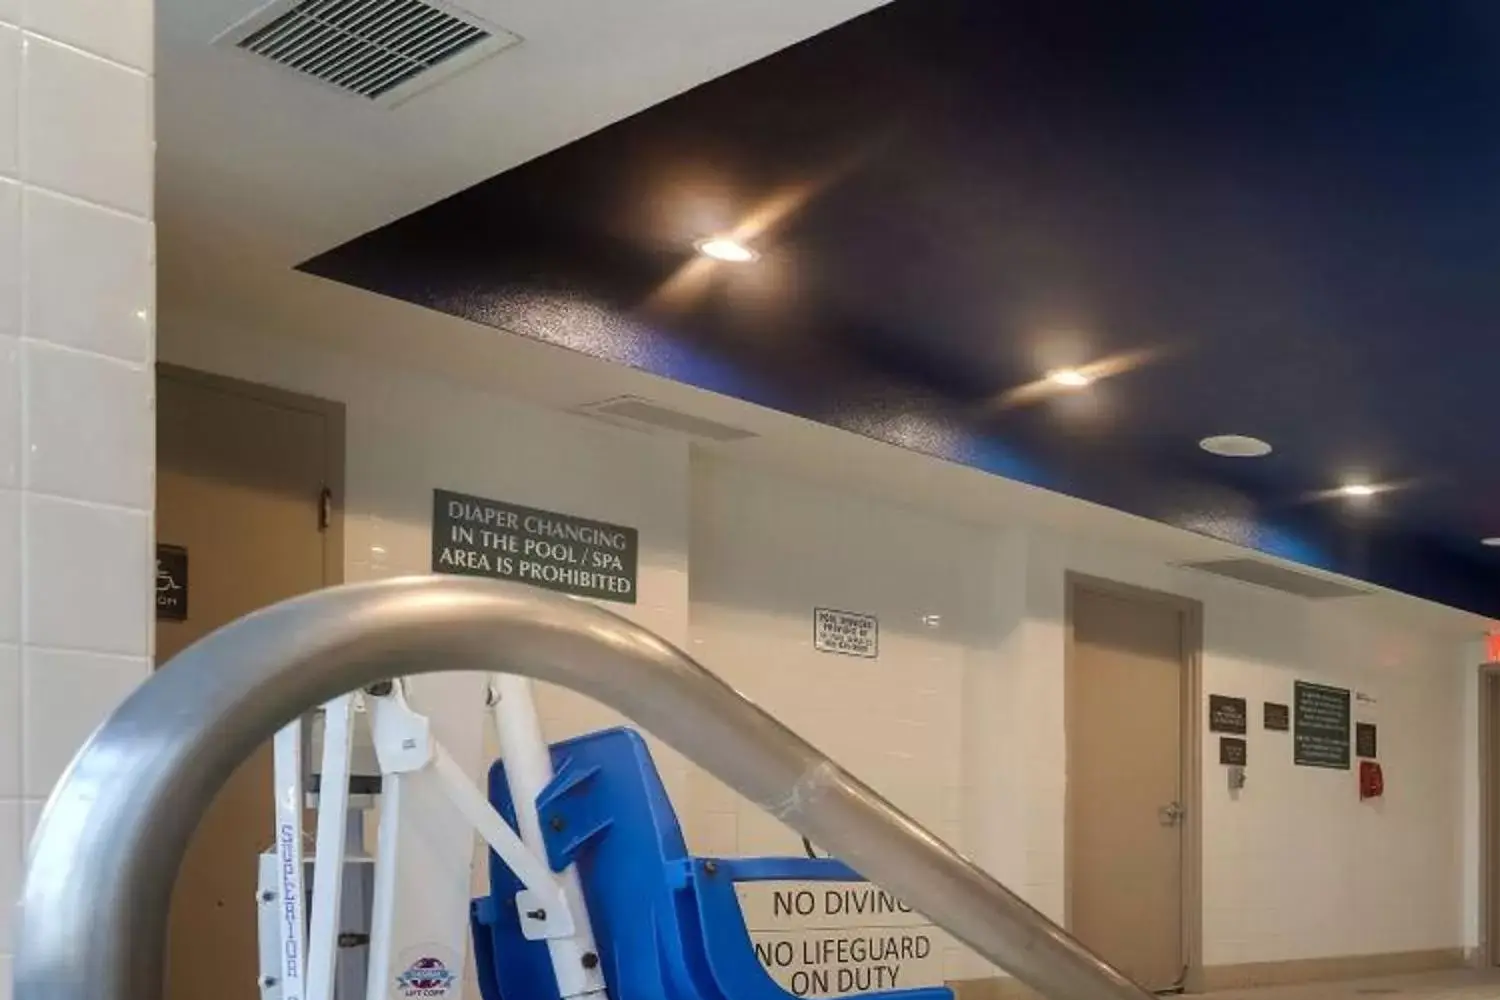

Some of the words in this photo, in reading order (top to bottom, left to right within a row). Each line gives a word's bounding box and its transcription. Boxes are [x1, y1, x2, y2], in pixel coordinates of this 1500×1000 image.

[448, 501, 518, 529] DIAPER
[524, 516, 626, 550] CHANGING
[451, 525, 473, 544] IN
[480, 531, 520, 552] THE
[525, 540, 577, 563] POOL
[592, 551, 623, 571] SPA
[439, 548, 491, 571] AREA
[497, 557, 513, 575] IS
[519, 560, 631, 593] PROHIBITED
[773, 891, 815, 917] NO
[755, 941, 794, 966] NO
[803, 935, 931, 964] LIFEGUARD
[791, 969, 828, 996] ON
[838, 965, 900, 992] DUTY
